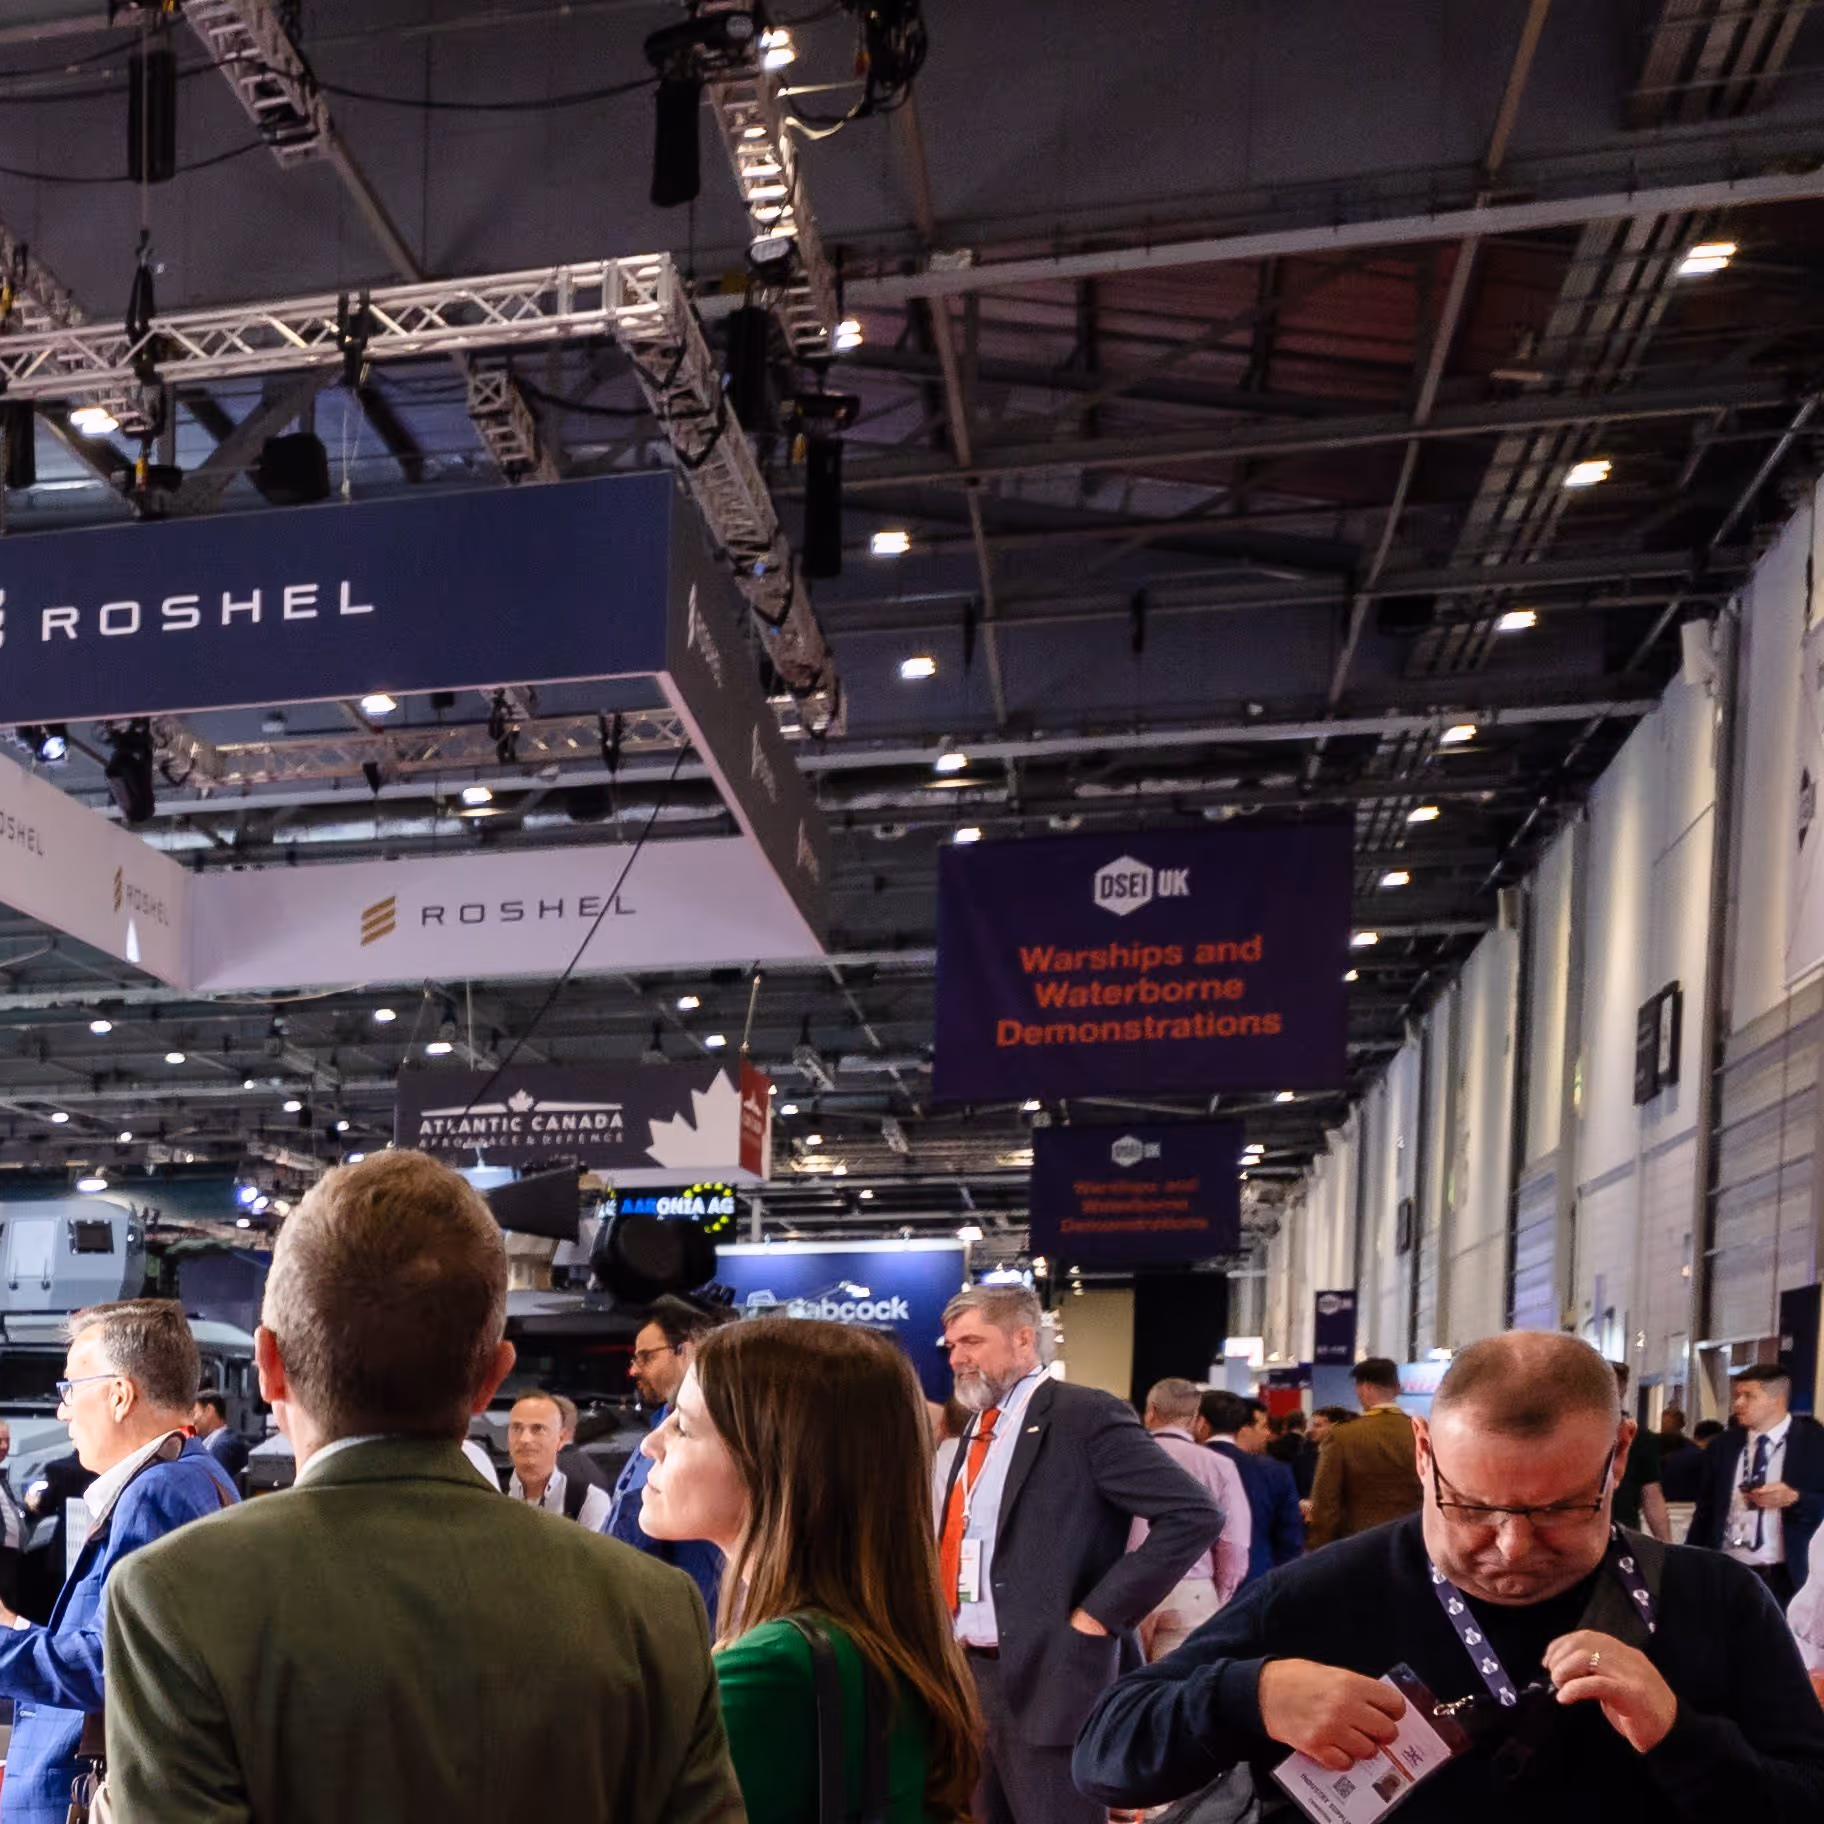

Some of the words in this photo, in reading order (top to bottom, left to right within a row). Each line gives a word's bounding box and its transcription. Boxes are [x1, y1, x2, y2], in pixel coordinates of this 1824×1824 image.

[40, 580, 374, 642] ROSHEL
[1100, 872, 1148, 899] DSEI
[1157, 868, 1190, 897] UK
[421, 894, 637, 927] ROSHEL
[1019, 940, 1184, 974] Warships
[1195, 935, 1264, 963] and
[1035, 976, 1244, 1008] Waterborne
[996, 1008, 1282, 1047] Demonstrations
[419, 1116, 522, 1135] ATLANTIC
[531, 1112, 624, 1132] CANADA
